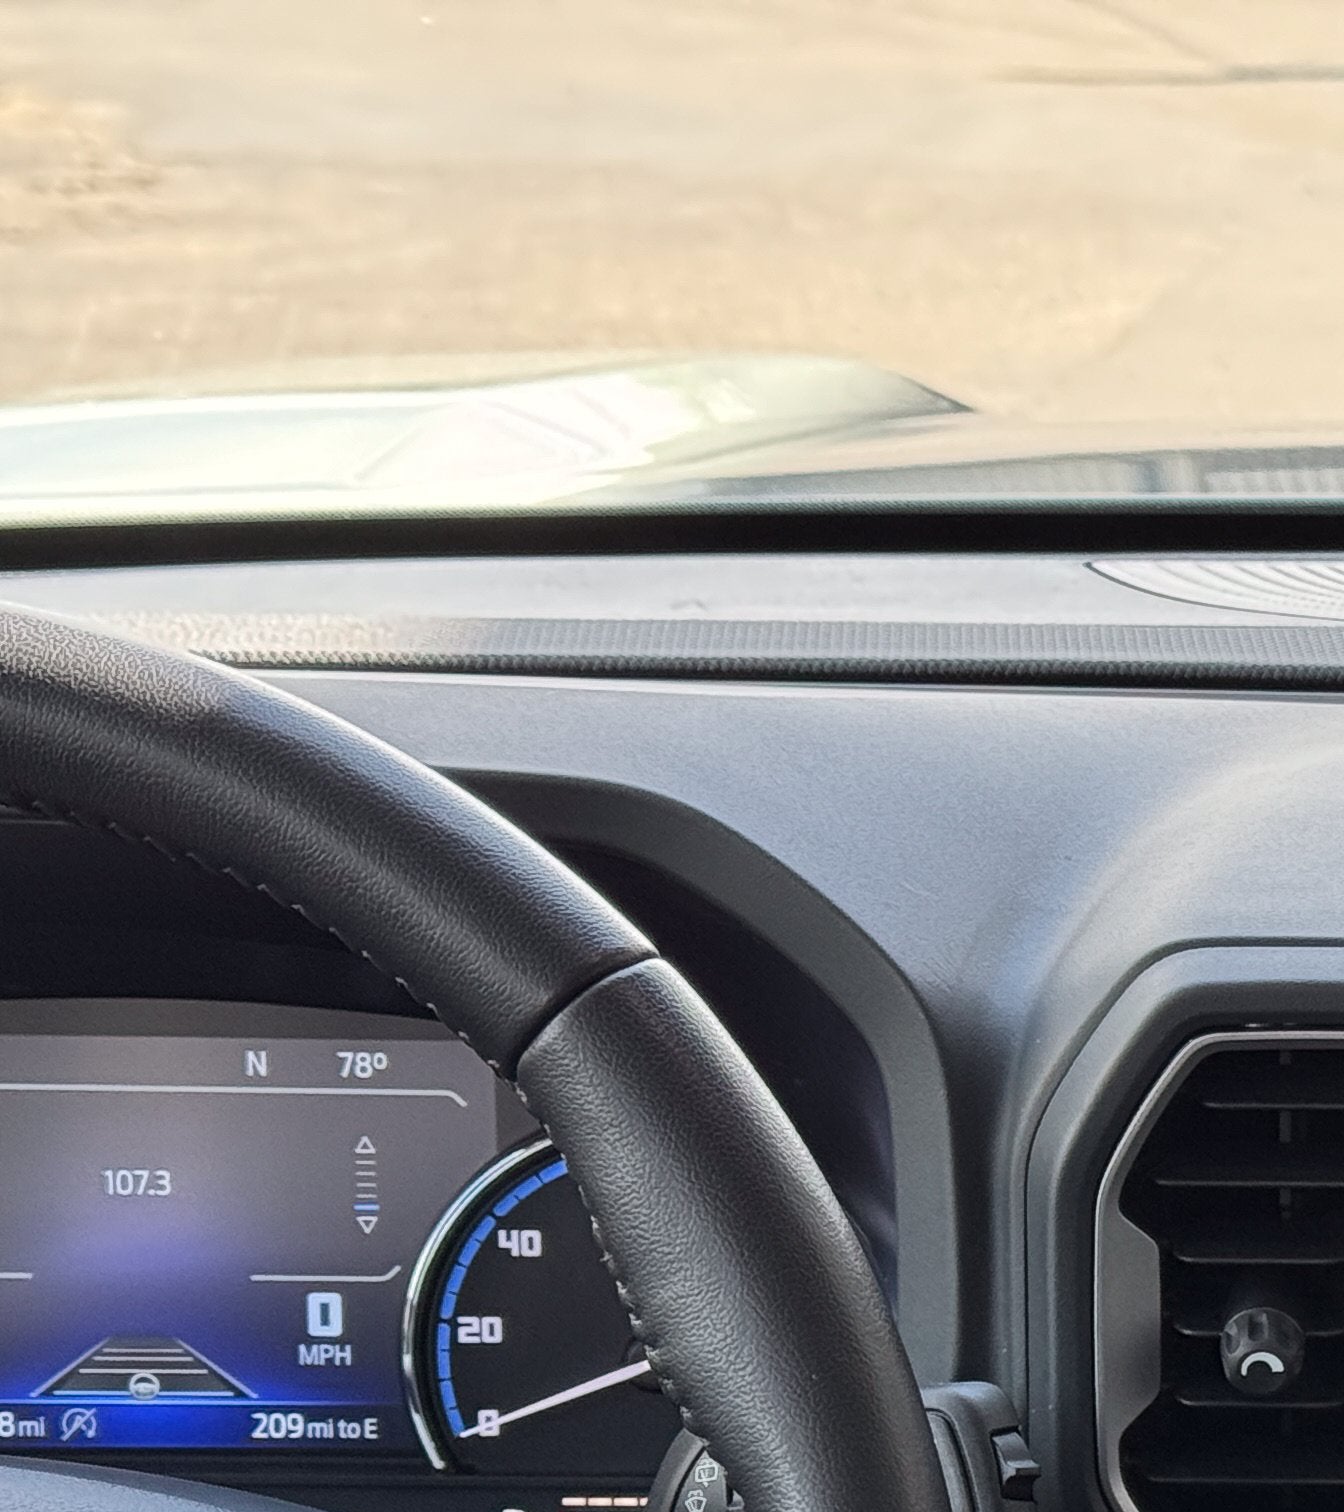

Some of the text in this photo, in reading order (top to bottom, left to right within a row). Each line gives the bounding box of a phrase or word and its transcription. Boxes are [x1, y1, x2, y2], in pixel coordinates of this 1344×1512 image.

[245, 1052, 267, 1075] N
[336, 1051, 388, 1078] 78°
[102, 1170, 172, 1196] 107.3
[498, 1230, 542, 1257] 40
[308, 1293, 343, 1337] 0
[457, 1317, 502, 1343] 20
[299, 1345, 352, 1366] MPH
[251, 1414, 379, 1439] 209 mi to E
